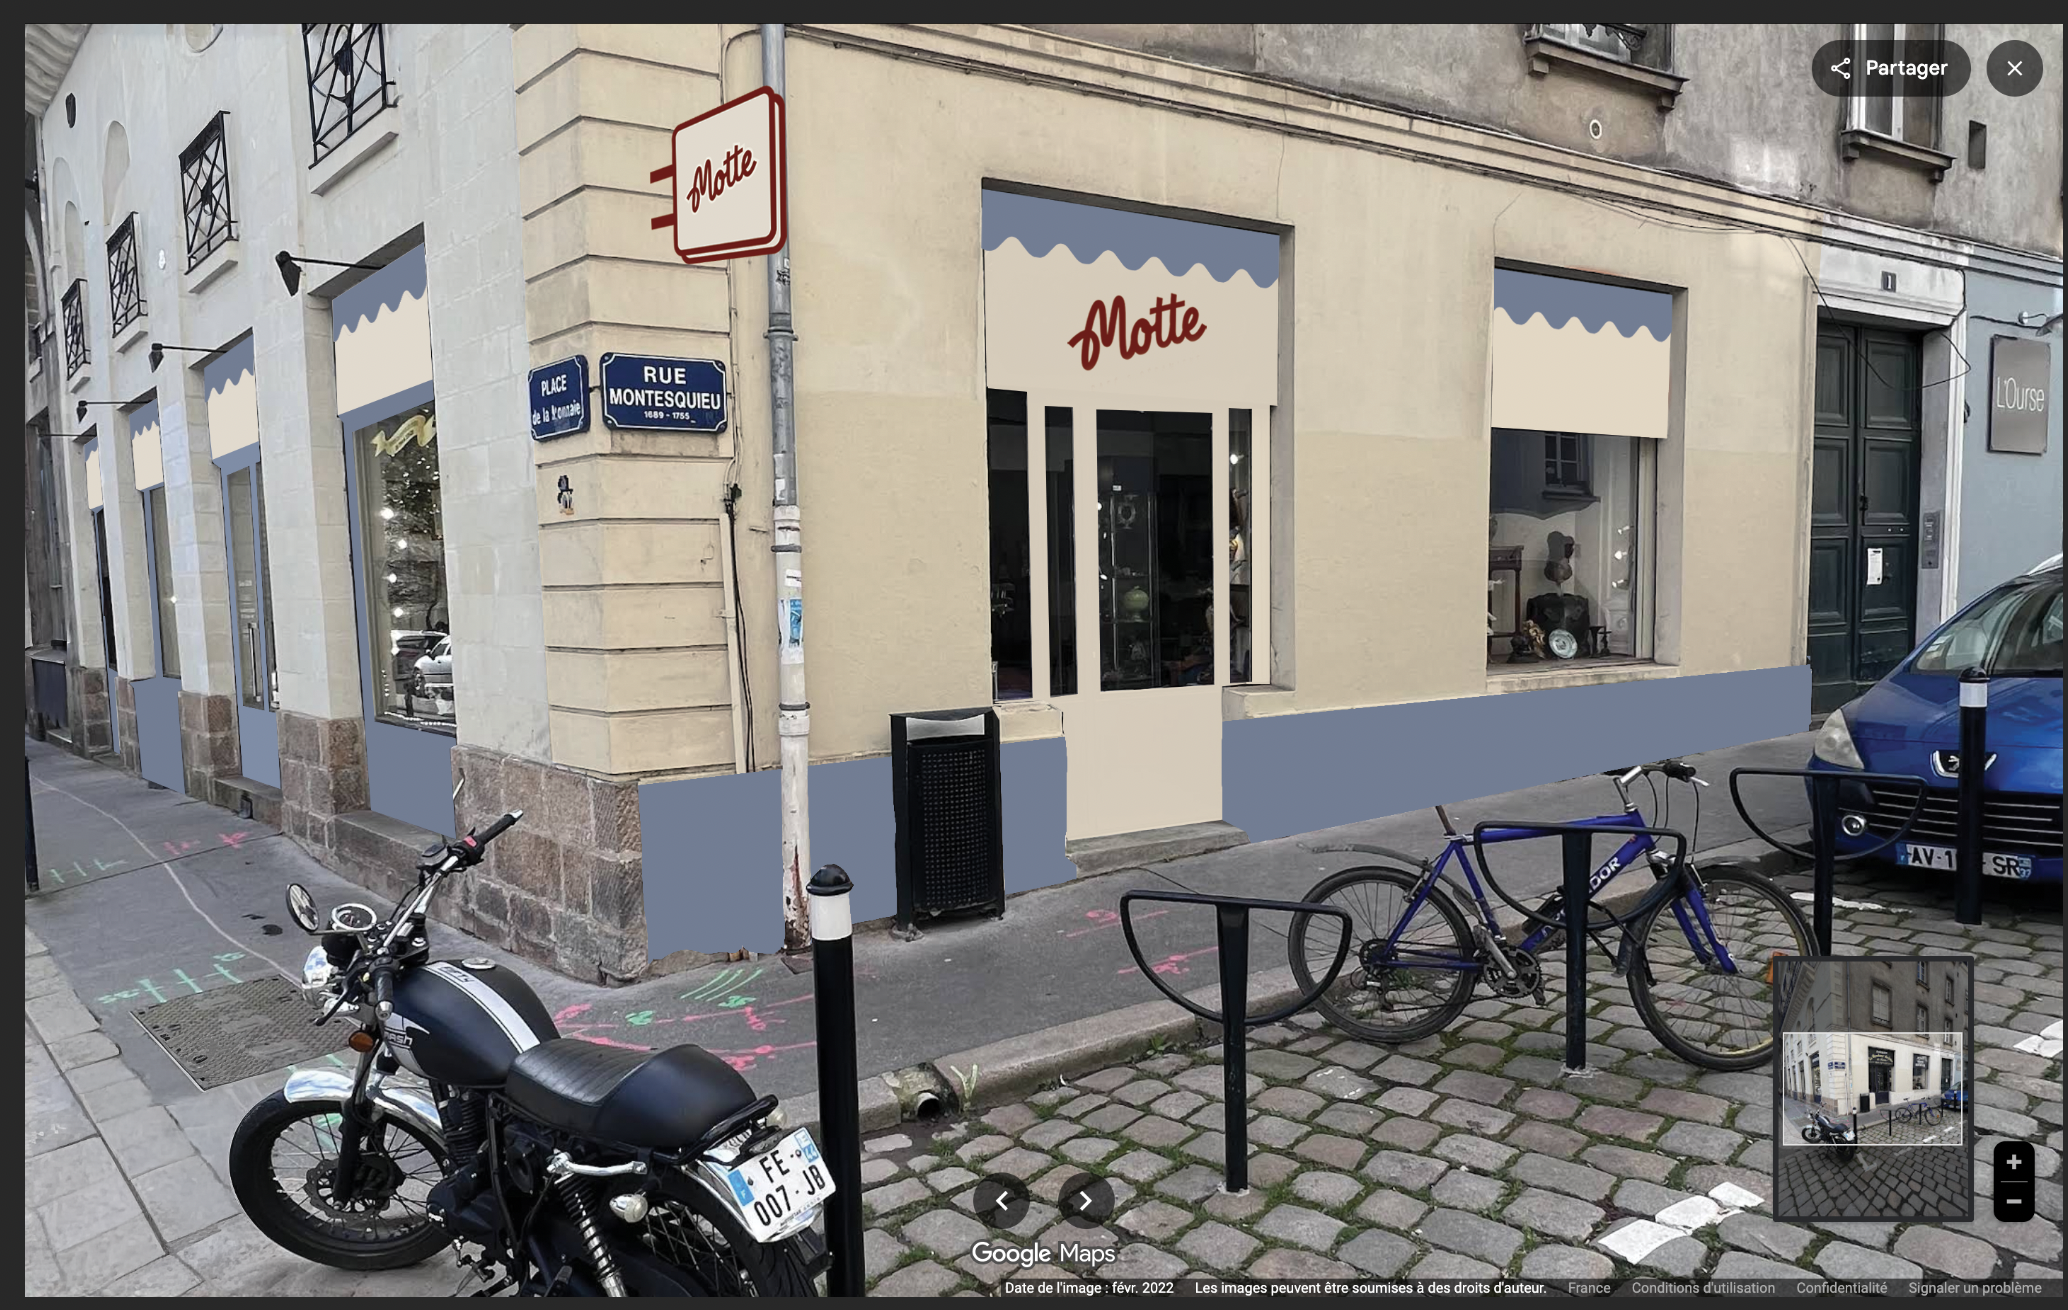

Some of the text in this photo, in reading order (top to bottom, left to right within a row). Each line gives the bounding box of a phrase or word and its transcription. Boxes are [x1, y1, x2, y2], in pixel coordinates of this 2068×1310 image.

[686, 144, 757, 213] Motte
[1067, 292, 1208, 371] Motte
[541, 374, 567, 397] PLACE
[643, 365, 687, 385] RUE
[609, 388, 721, 410] MONTESQUIEU
[1996, 376, 2045, 412] L'Ourse
[532, 409, 541, 426] de
[543, 407, 550, 423] la
[644, 411, 664, 419] 1689
[672, 411, 690, 420] 1755
